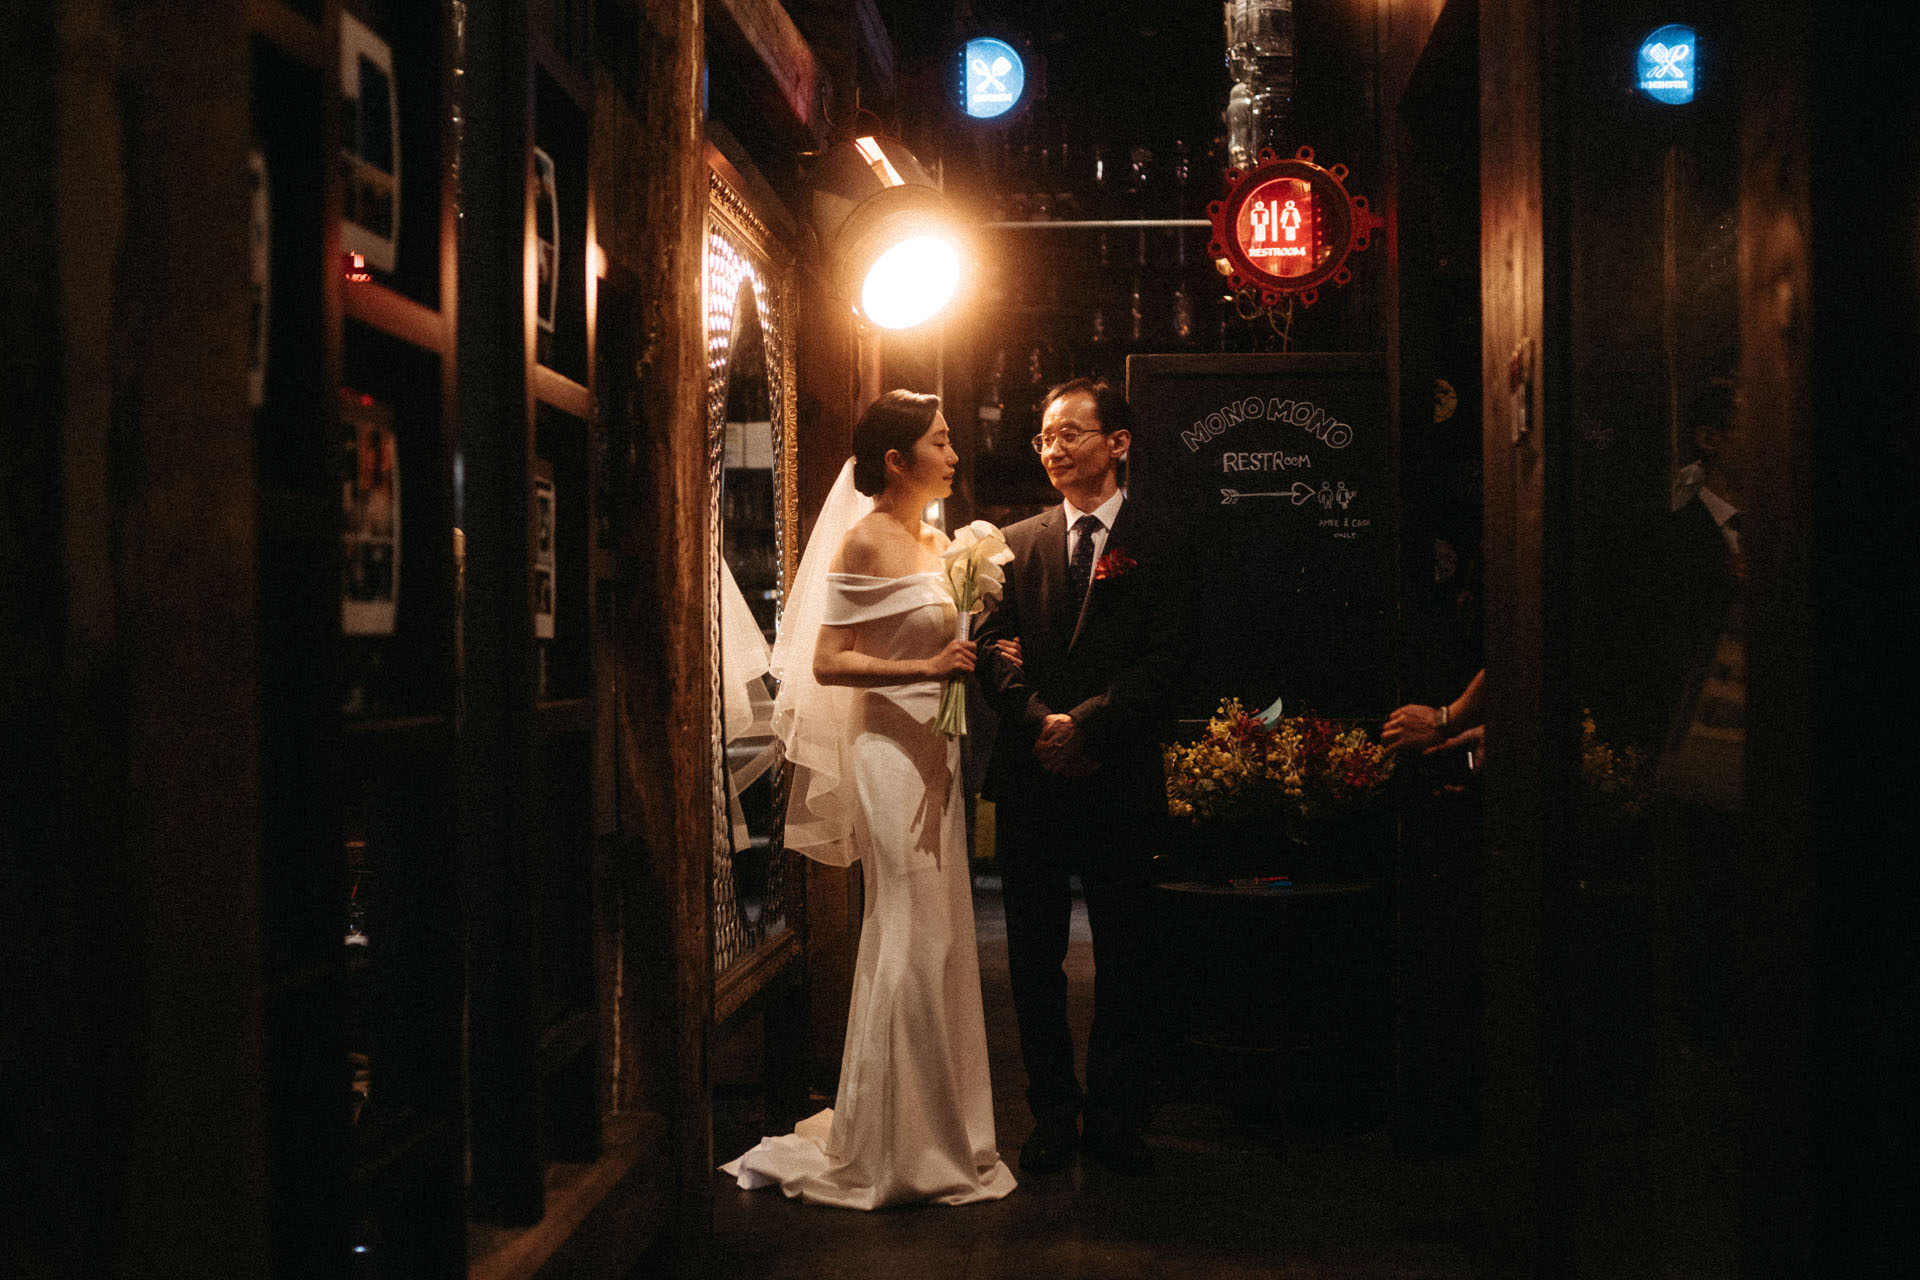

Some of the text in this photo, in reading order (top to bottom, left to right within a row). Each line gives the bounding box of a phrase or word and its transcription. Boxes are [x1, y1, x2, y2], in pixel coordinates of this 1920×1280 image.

[1248, 246, 1306, 257] RESTROOM
[1180, 396, 1353, 453] MONO MONO
